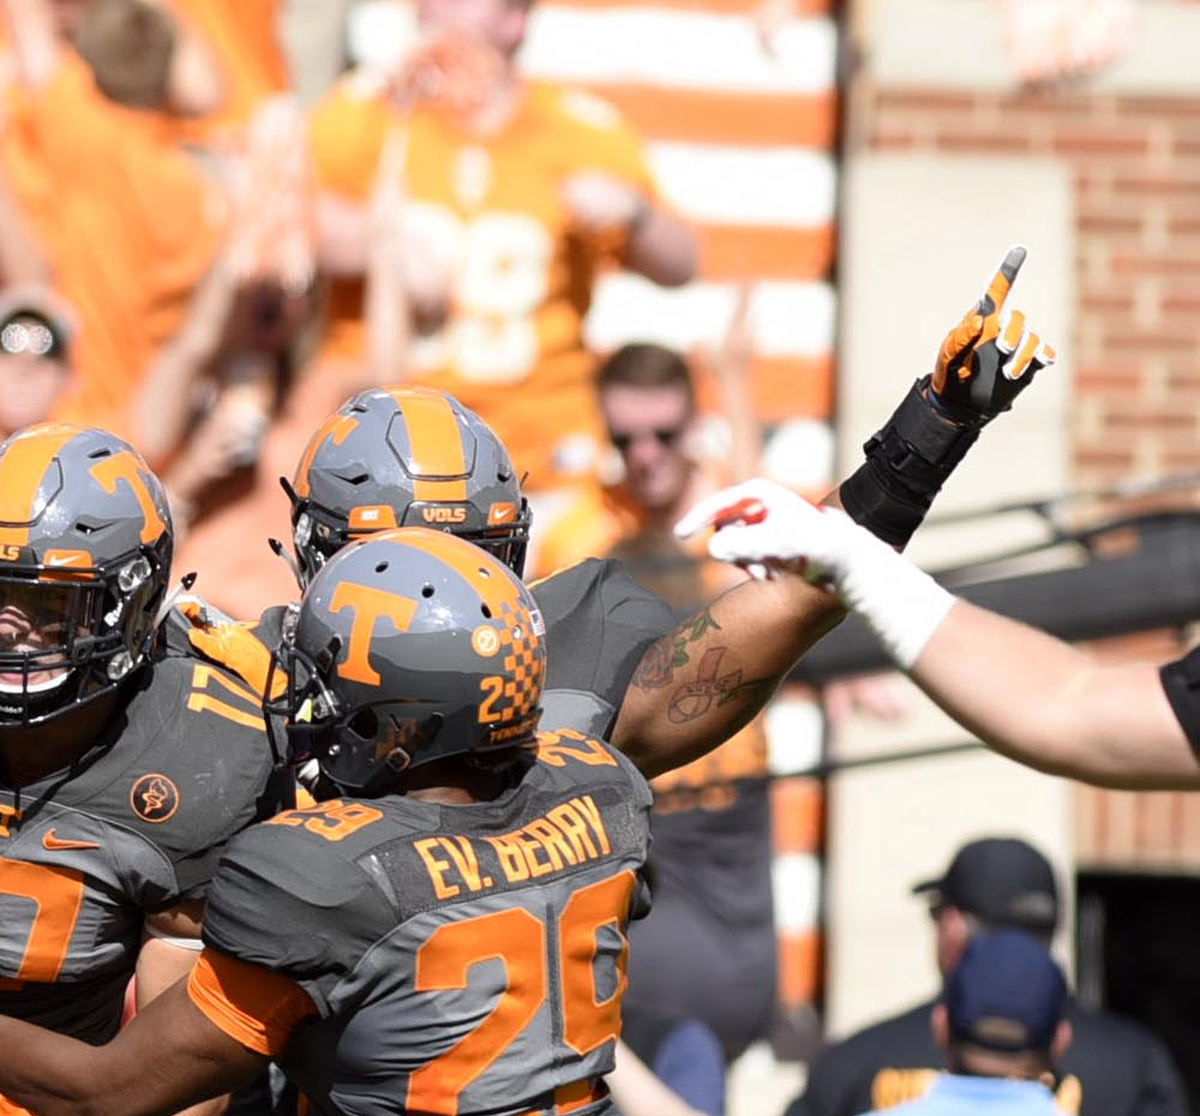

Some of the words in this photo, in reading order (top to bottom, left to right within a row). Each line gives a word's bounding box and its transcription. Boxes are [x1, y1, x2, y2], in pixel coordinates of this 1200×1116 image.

[89, 451, 167, 545] T
[422, 507, 467, 523] VOLS
[329, 580, 419, 688] T
[268, 799, 384, 841] 29
[413, 834, 494, 900] EV.
[480, 794, 611, 884] BERRY
